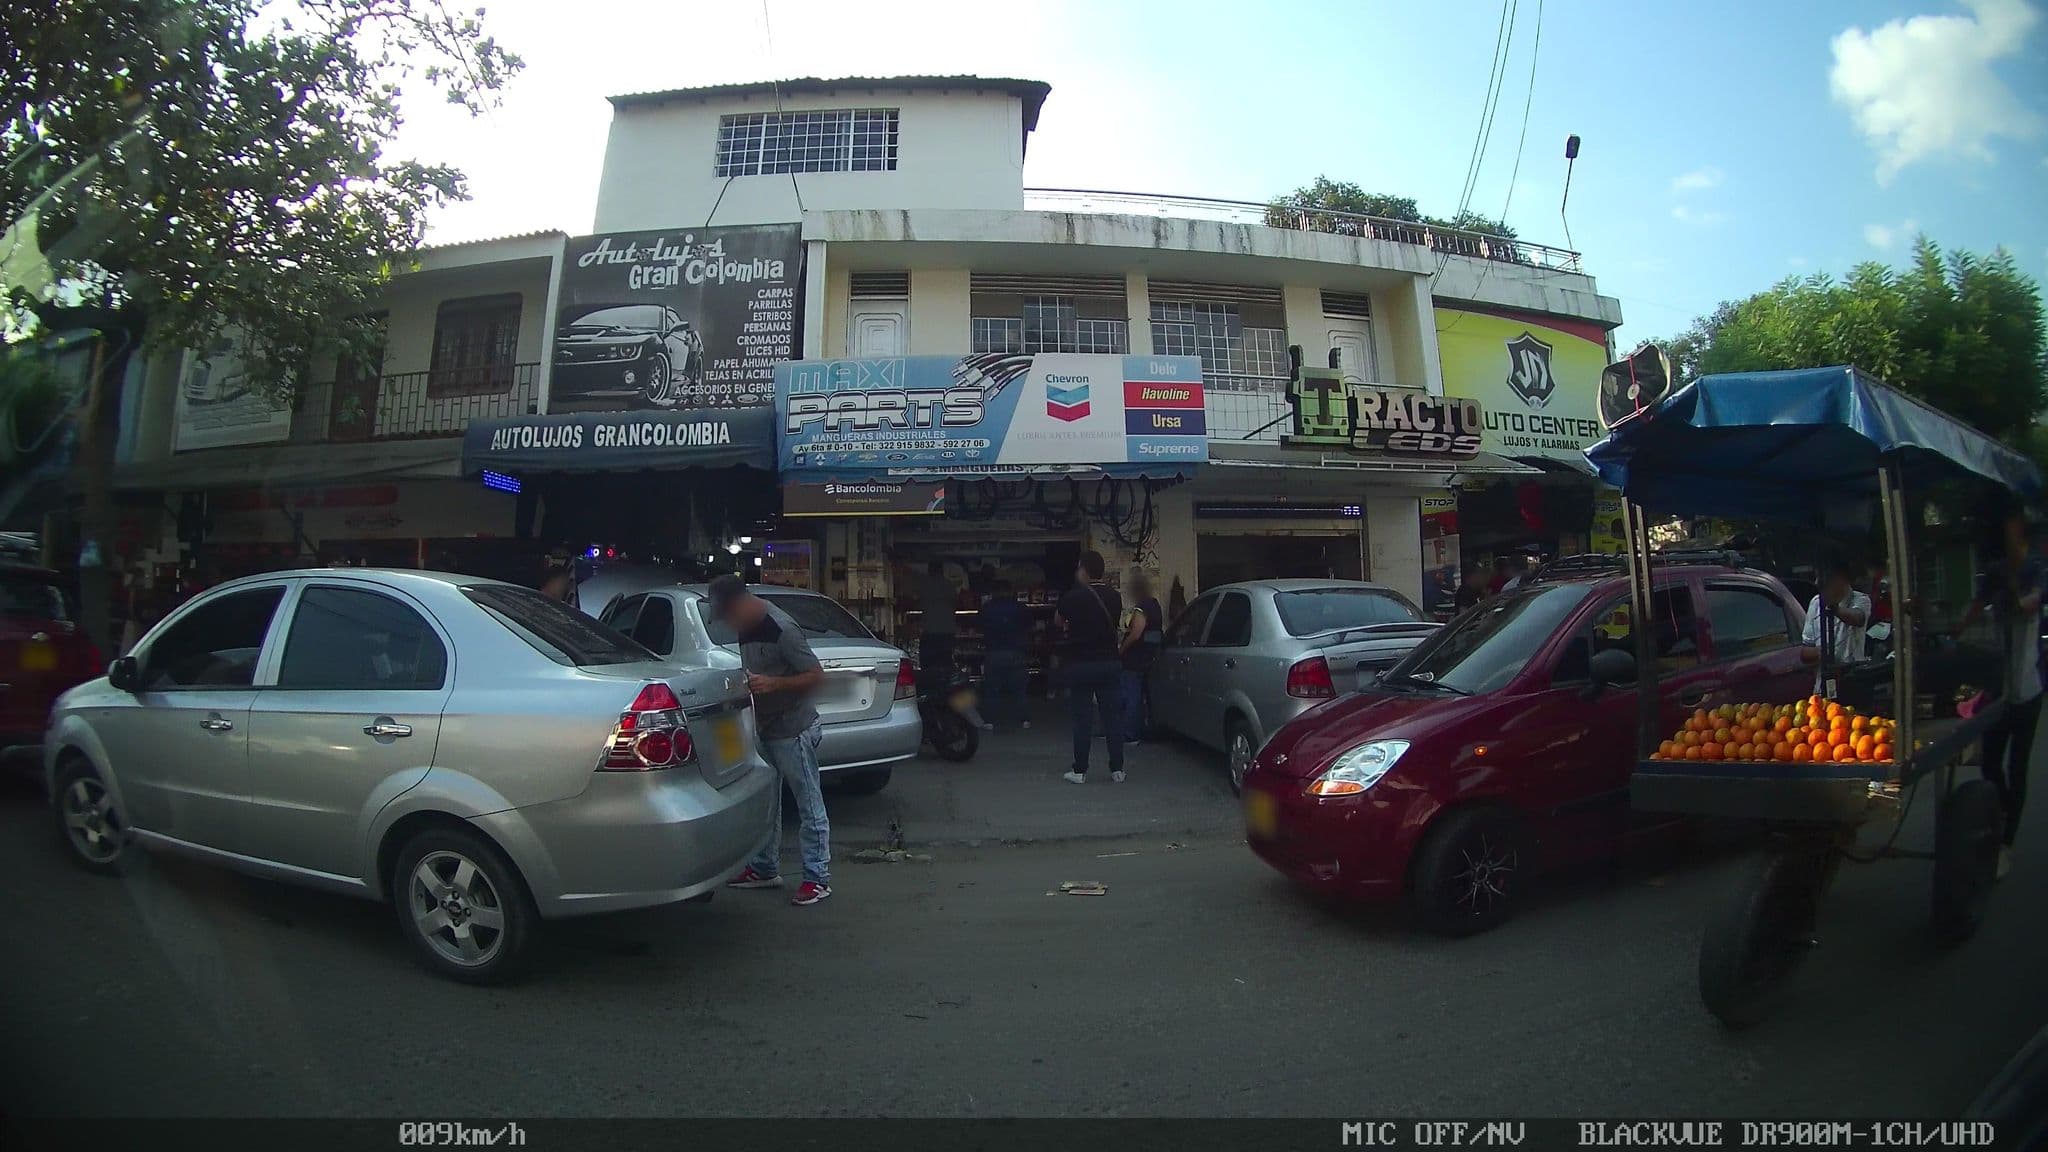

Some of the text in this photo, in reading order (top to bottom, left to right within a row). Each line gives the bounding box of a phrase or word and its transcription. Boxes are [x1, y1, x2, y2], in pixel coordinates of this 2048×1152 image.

[629, 257, 784, 290] Gran Colombia
[757, 288, 793, 299] CARPAS
[748, 299, 793, 310] PARRILLAS
[753, 311, 792, 321] ESTRIBOS
[744, 321, 792, 333] PERSIANAS
[736, 334, 791, 345] CROMADOS
[745, 345, 791, 356] LUCES HID
[713, 358, 740, 369] PAPEL
[1150, 361, 1177, 375] Delo
[705, 370, 730, 380] TEJAS
[732, 370, 744, 380] EN
[789, 358, 906, 393] MAXI
[1045, 373, 1089, 383] Chevron
[674, 384, 732, 396] ACCESORIOS
[734, 384, 746, 394] EN
[1142, 387, 1191, 401] Havoline
[786, 386, 985, 435] PARTS
[1152, 414, 1182, 428] Ursa
[1482, 411, 1600, 438] UTO CENTER
[491, 422, 730, 450] AUTOLUJOS GRANCOLOMBIA
[812, 431, 946, 443] MANGUERAS INDUSTRIALES
[1353, 429, 1482, 454] LEDS
[861, 442, 877, 450] Tel:
[897, 441, 913, 449] 915
[915, 441, 935, 449] 9832
[943, 440, 959, 448] 592
[961, 440, 972, 448] 27
[973, 439, 985, 447] 06
[1503, 436, 1580, 450] LUJOS Y ALARMAS
[1139, 442, 1200, 457] Supreme
[836, 484, 902, 494] Bancolombia
[1424, 498, 1454, 506] STOP
